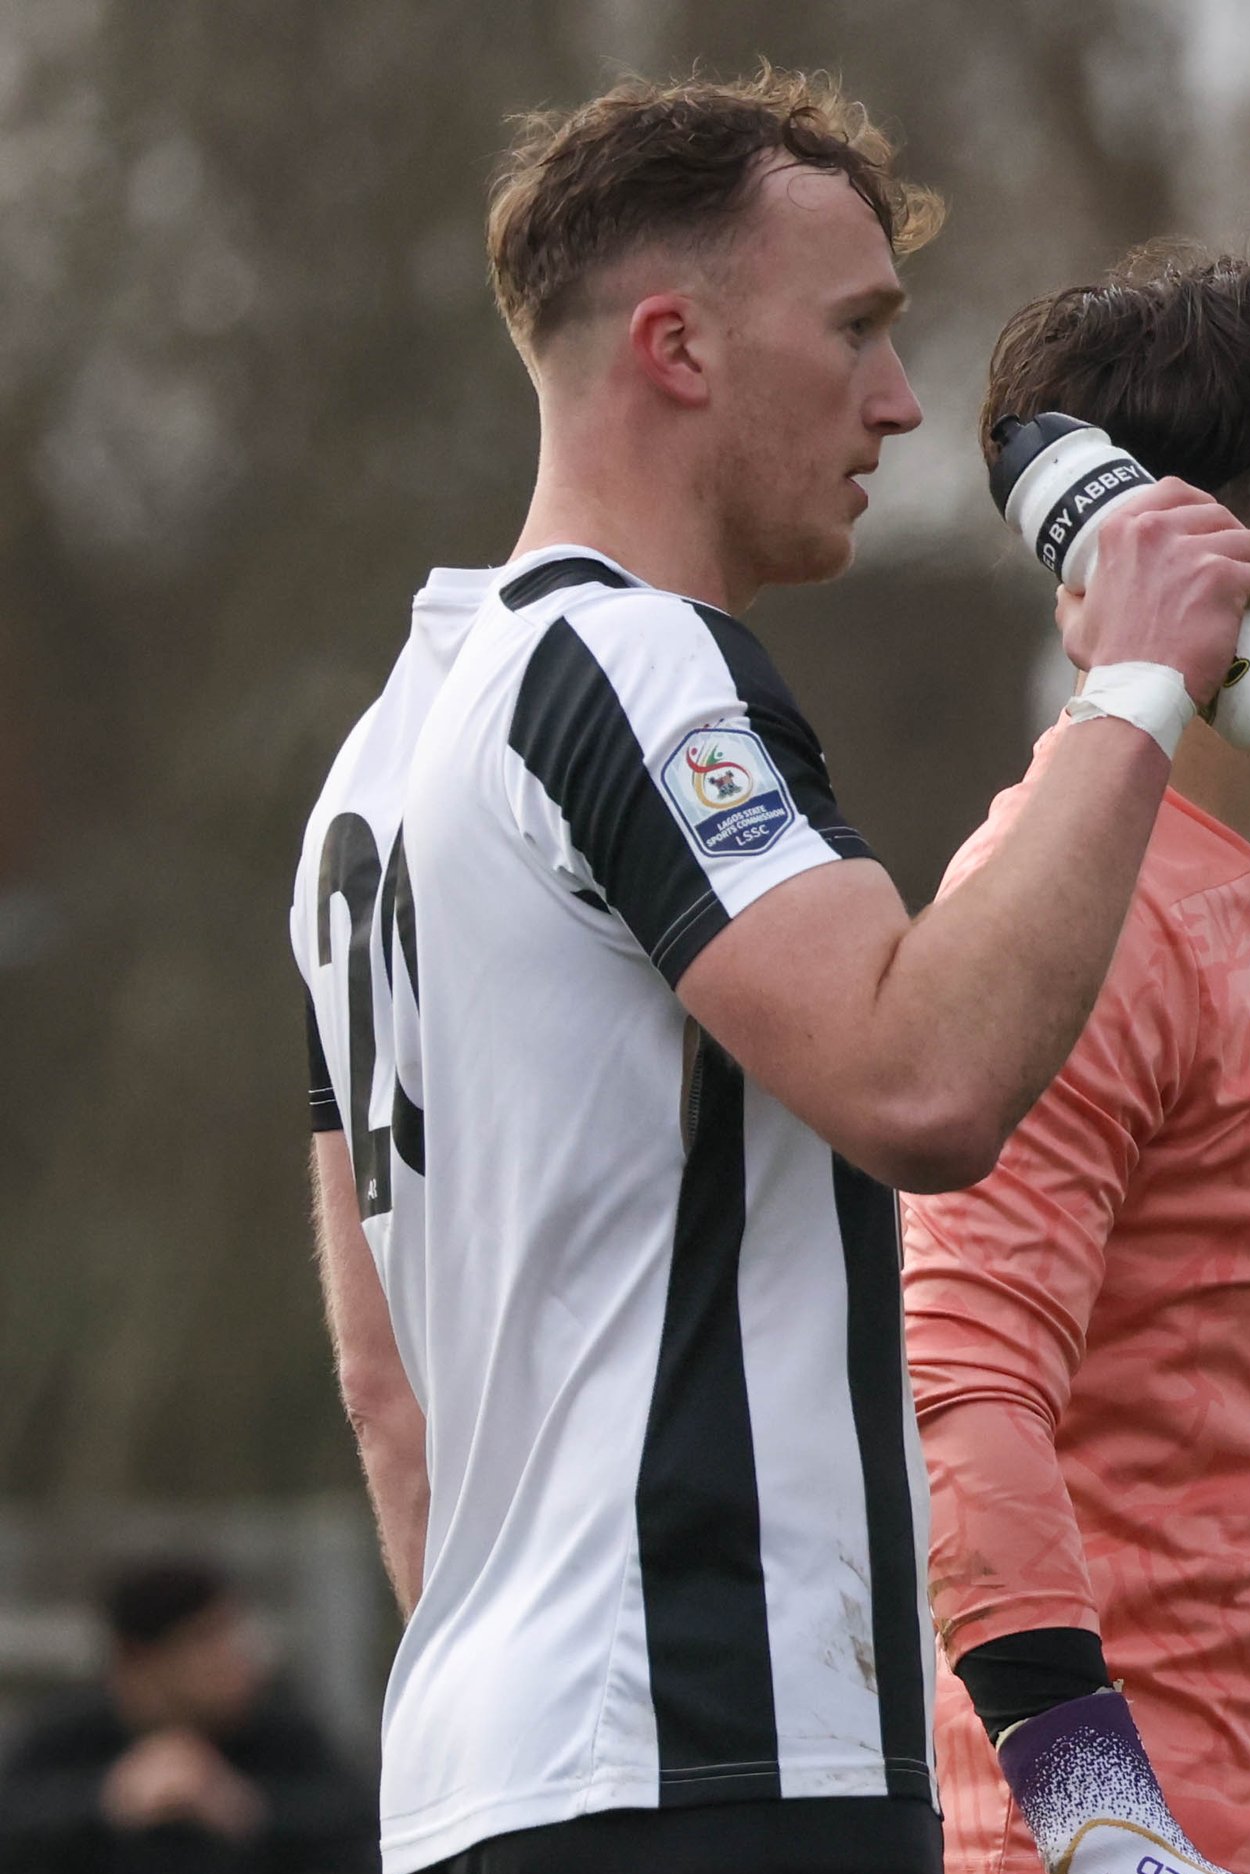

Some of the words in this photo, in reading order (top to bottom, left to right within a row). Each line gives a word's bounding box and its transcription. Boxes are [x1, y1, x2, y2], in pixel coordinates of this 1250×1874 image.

[1049, 508, 1073, 544] BY
[1074, 465, 1140, 514] ABBEY
[706, 825, 738, 847] SPORTS
[736, 808, 785, 829] COMMISSION
[717, 812, 744, 831] LAGOS
[743, 804, 767, 818] STATE
[735, 824, 769, 846] LSSC
